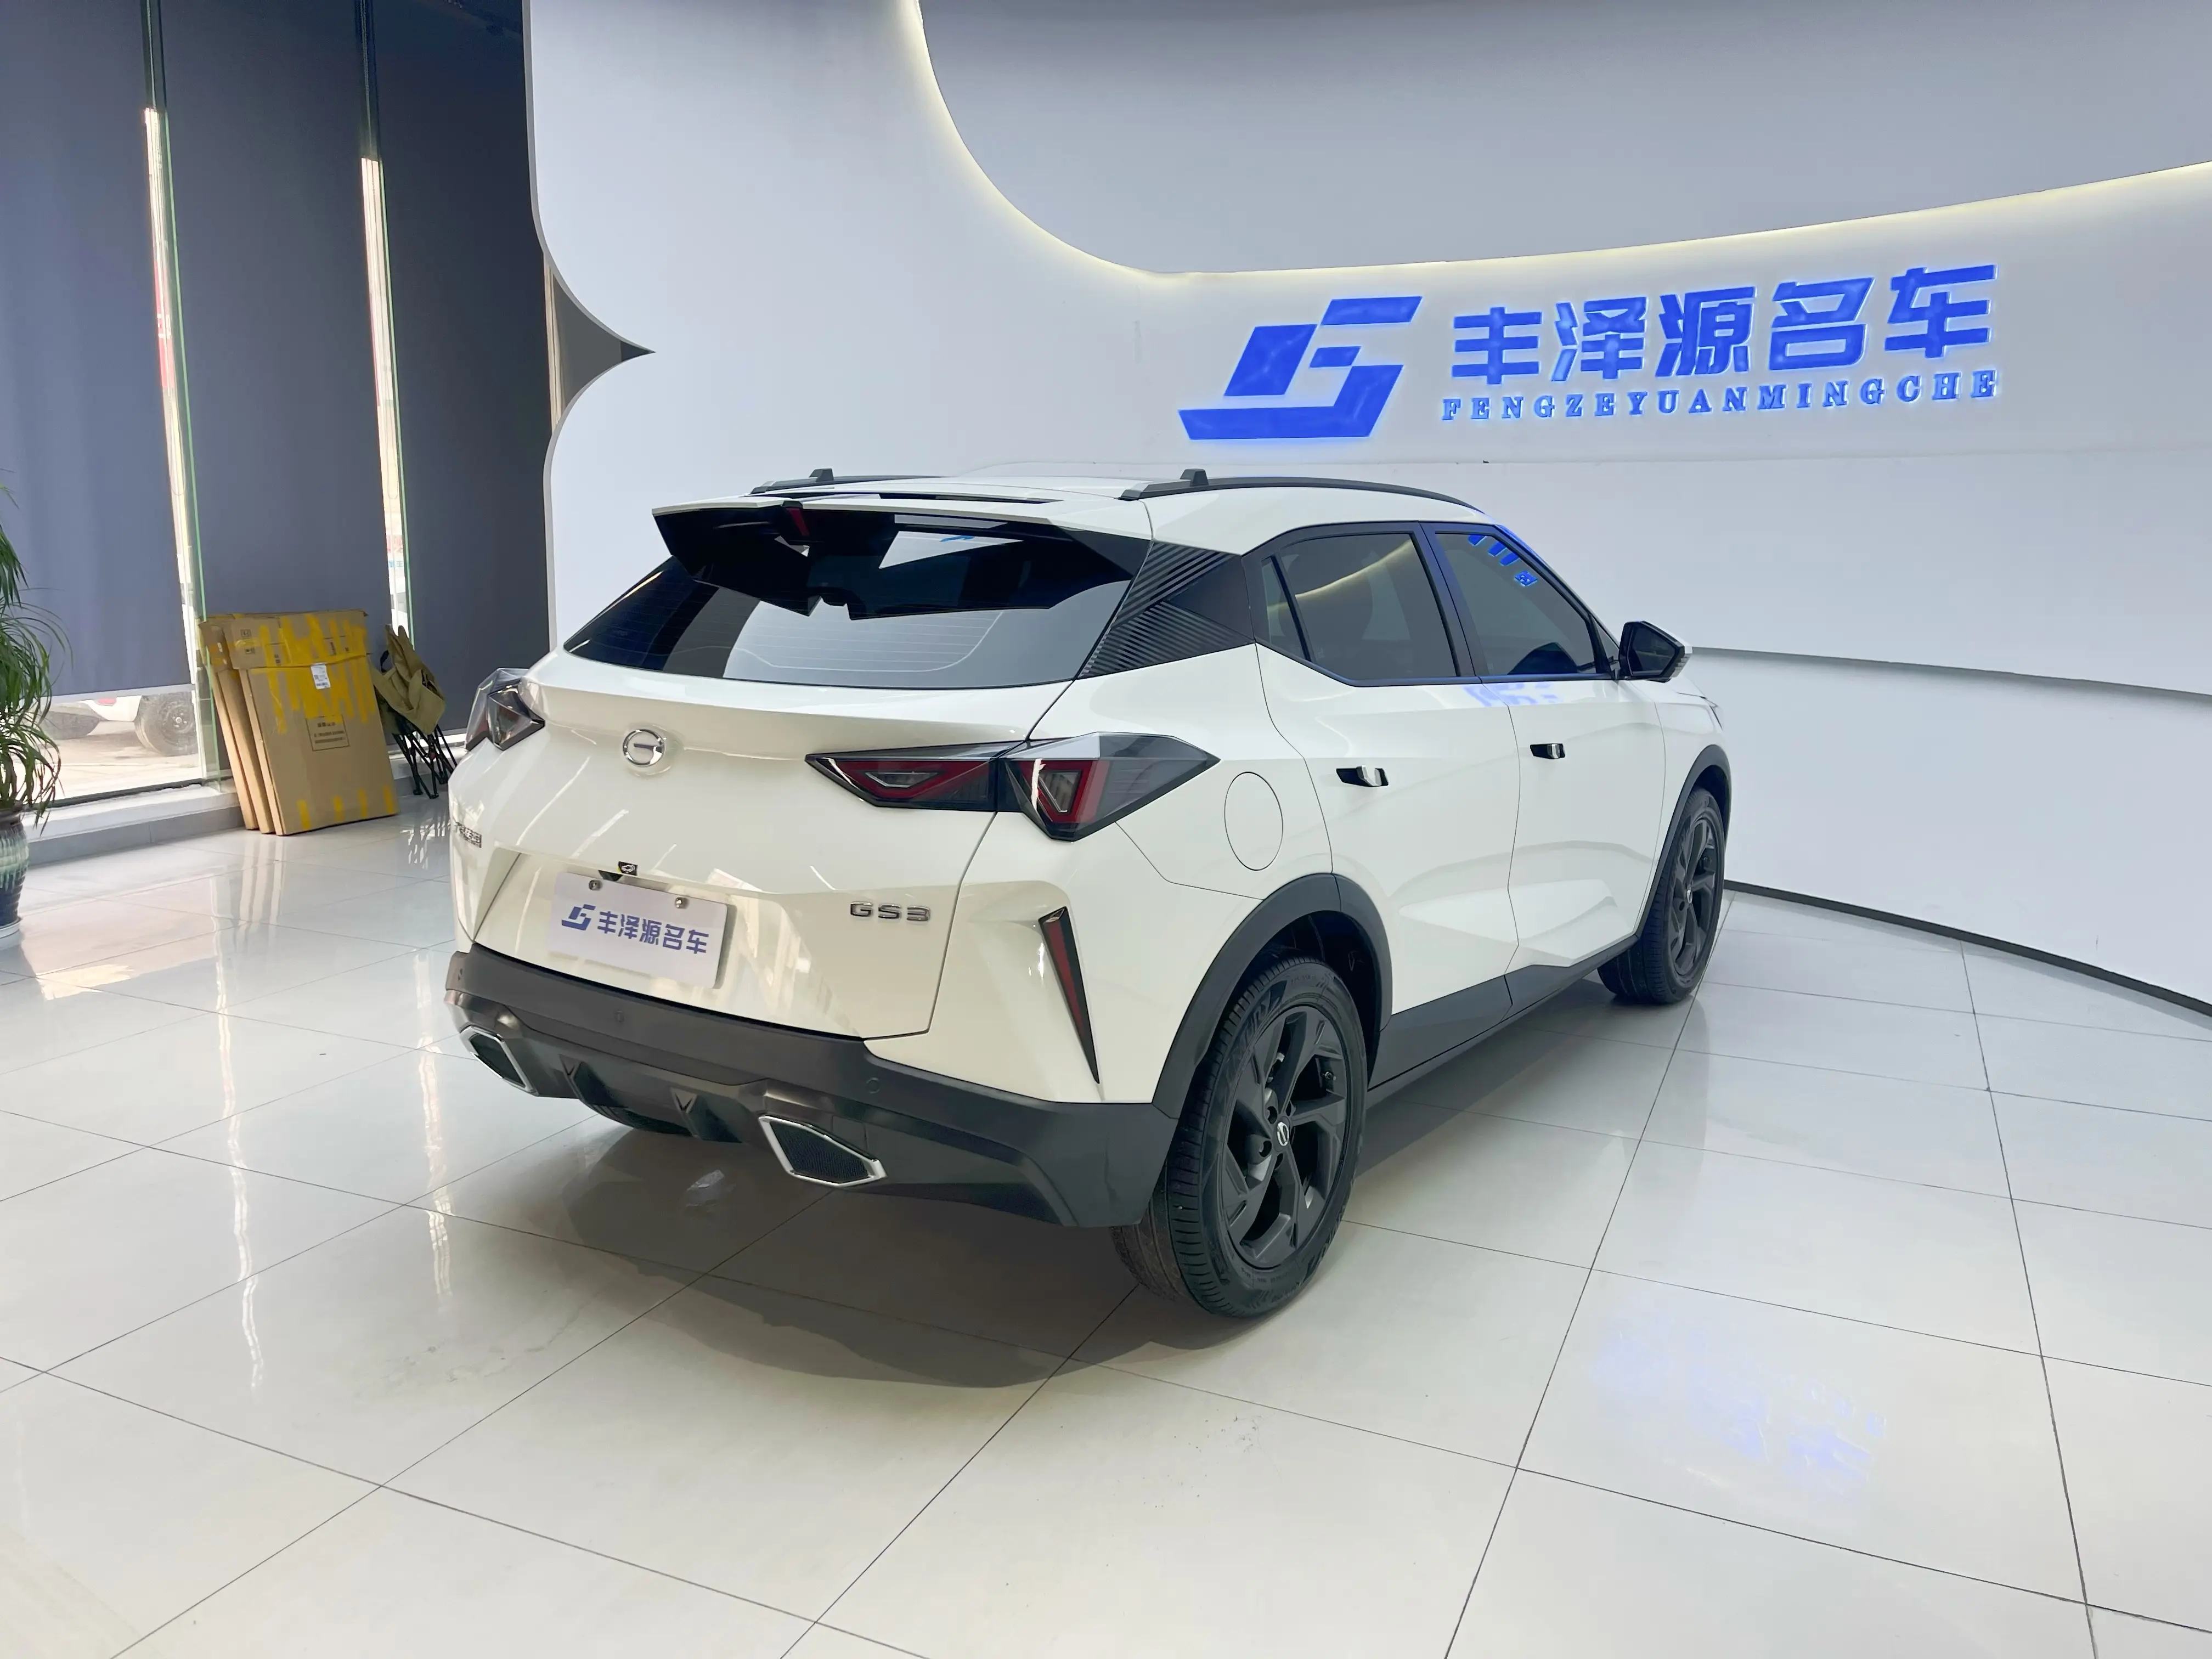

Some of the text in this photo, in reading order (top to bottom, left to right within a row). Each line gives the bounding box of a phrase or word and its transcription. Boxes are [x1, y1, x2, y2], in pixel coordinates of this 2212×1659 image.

[1451, 264, 1997, 385] 丰泽源名车
[1441, 370, 1997, 421] FENGZEYUANMINGCHE
[597, 911, 709, 954] 丰泽源名车
[850, 901, 930, 922] GS3
